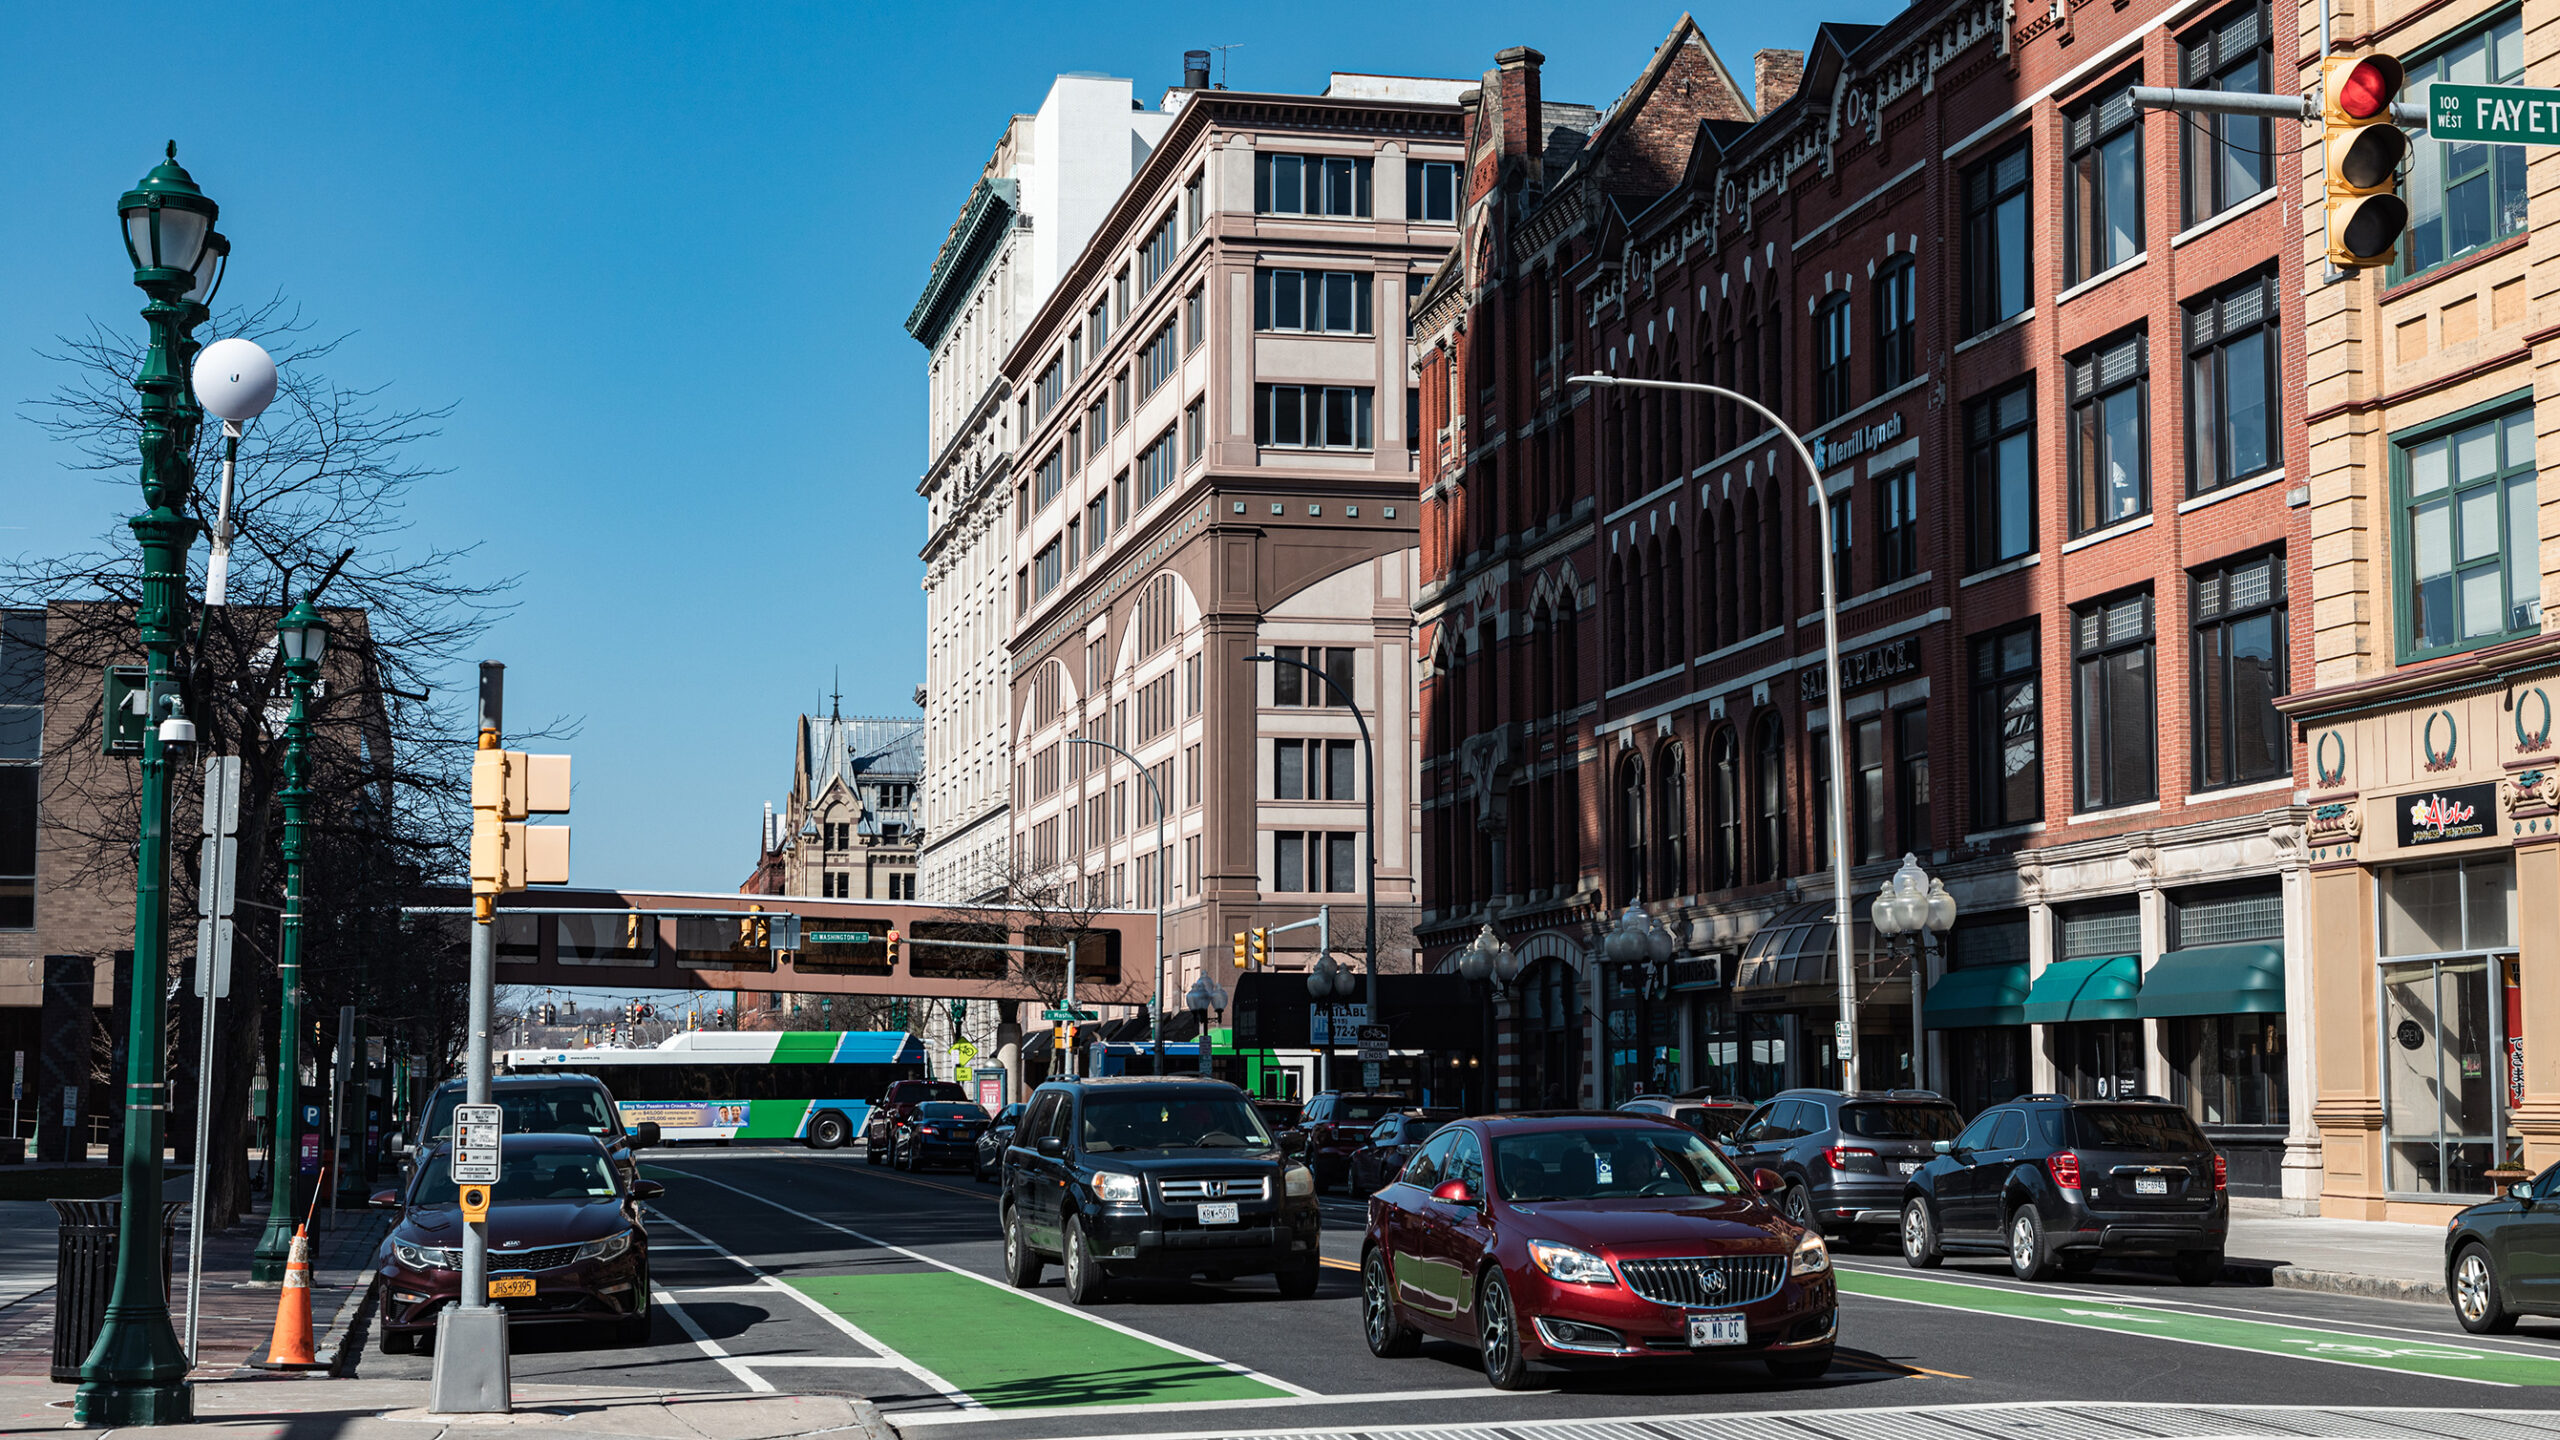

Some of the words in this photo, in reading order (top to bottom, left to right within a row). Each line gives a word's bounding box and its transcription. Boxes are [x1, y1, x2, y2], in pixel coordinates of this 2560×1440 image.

[2440, 96, 2459, 110] 100
[2438, 114, 2462, 128] WEST
[2477, 98, 2560, 133] FAYET
[1828, 428, 1863, 467] Merrill
[1865, 411, 1901, 451] Lynch
[1801, 658, 1853, 700] SALA
[2424, 793, 2474, 834] Aloha
[1314, 1007, 1366, 1016] AVILABL
[2400, 1029, 2422, 1041] OPEN
[307, 1107, 318, 1123] P
[1712, 1322, 1723, 1339] MR
[1728, 1321, 1739, 1338] CC
